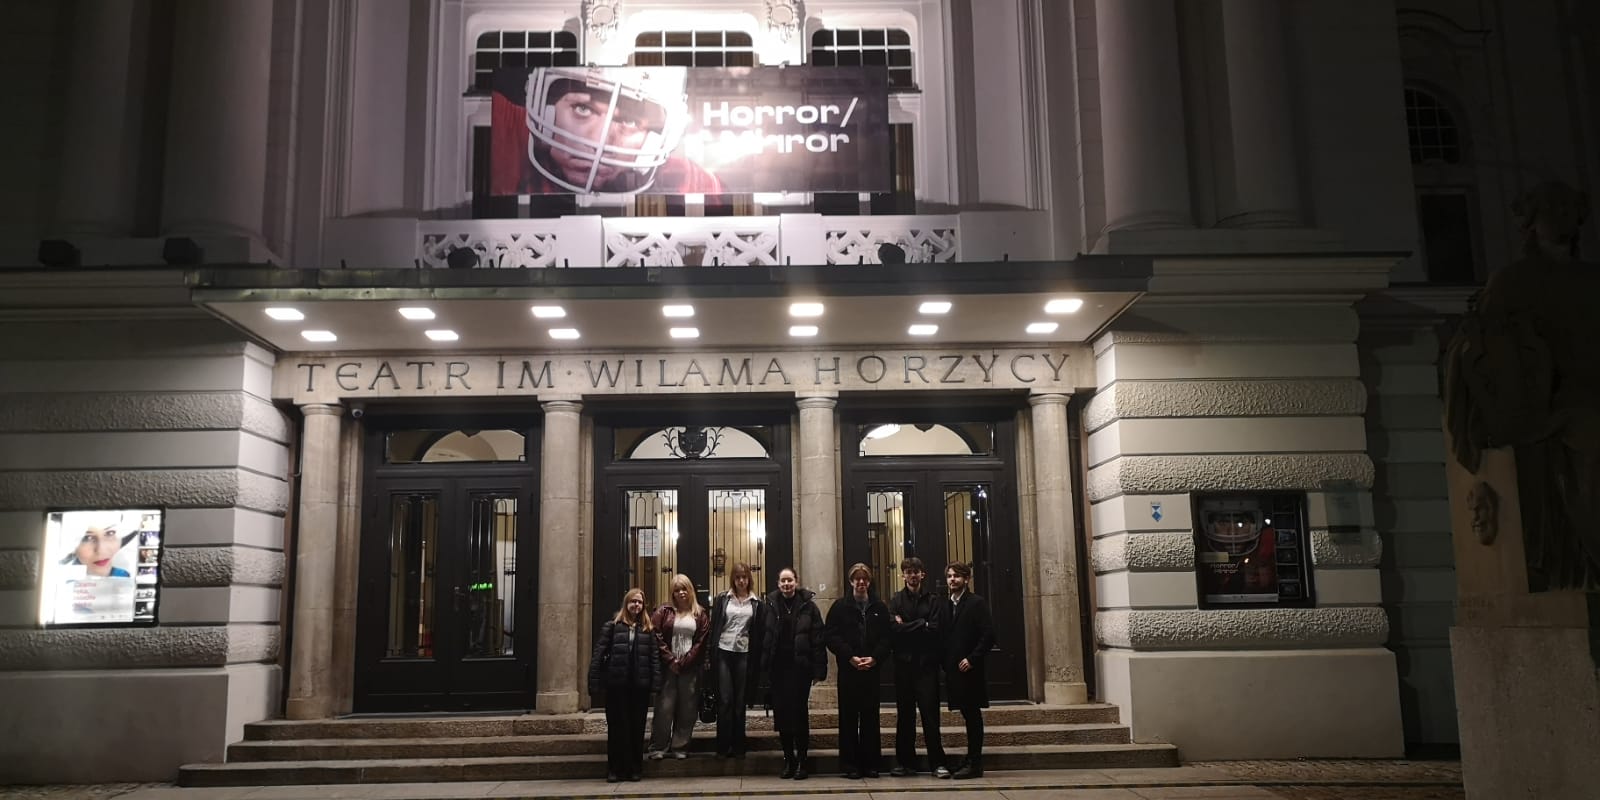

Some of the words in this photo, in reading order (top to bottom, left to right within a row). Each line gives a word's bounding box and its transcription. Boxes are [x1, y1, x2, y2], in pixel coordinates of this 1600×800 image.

[703, 97, 859, 127] Horror/
[297, 360, 472, 393] TEATR
[583, 358, 791, 388] WILAMA
[813, 353, 1070, 385] HORZYCY
